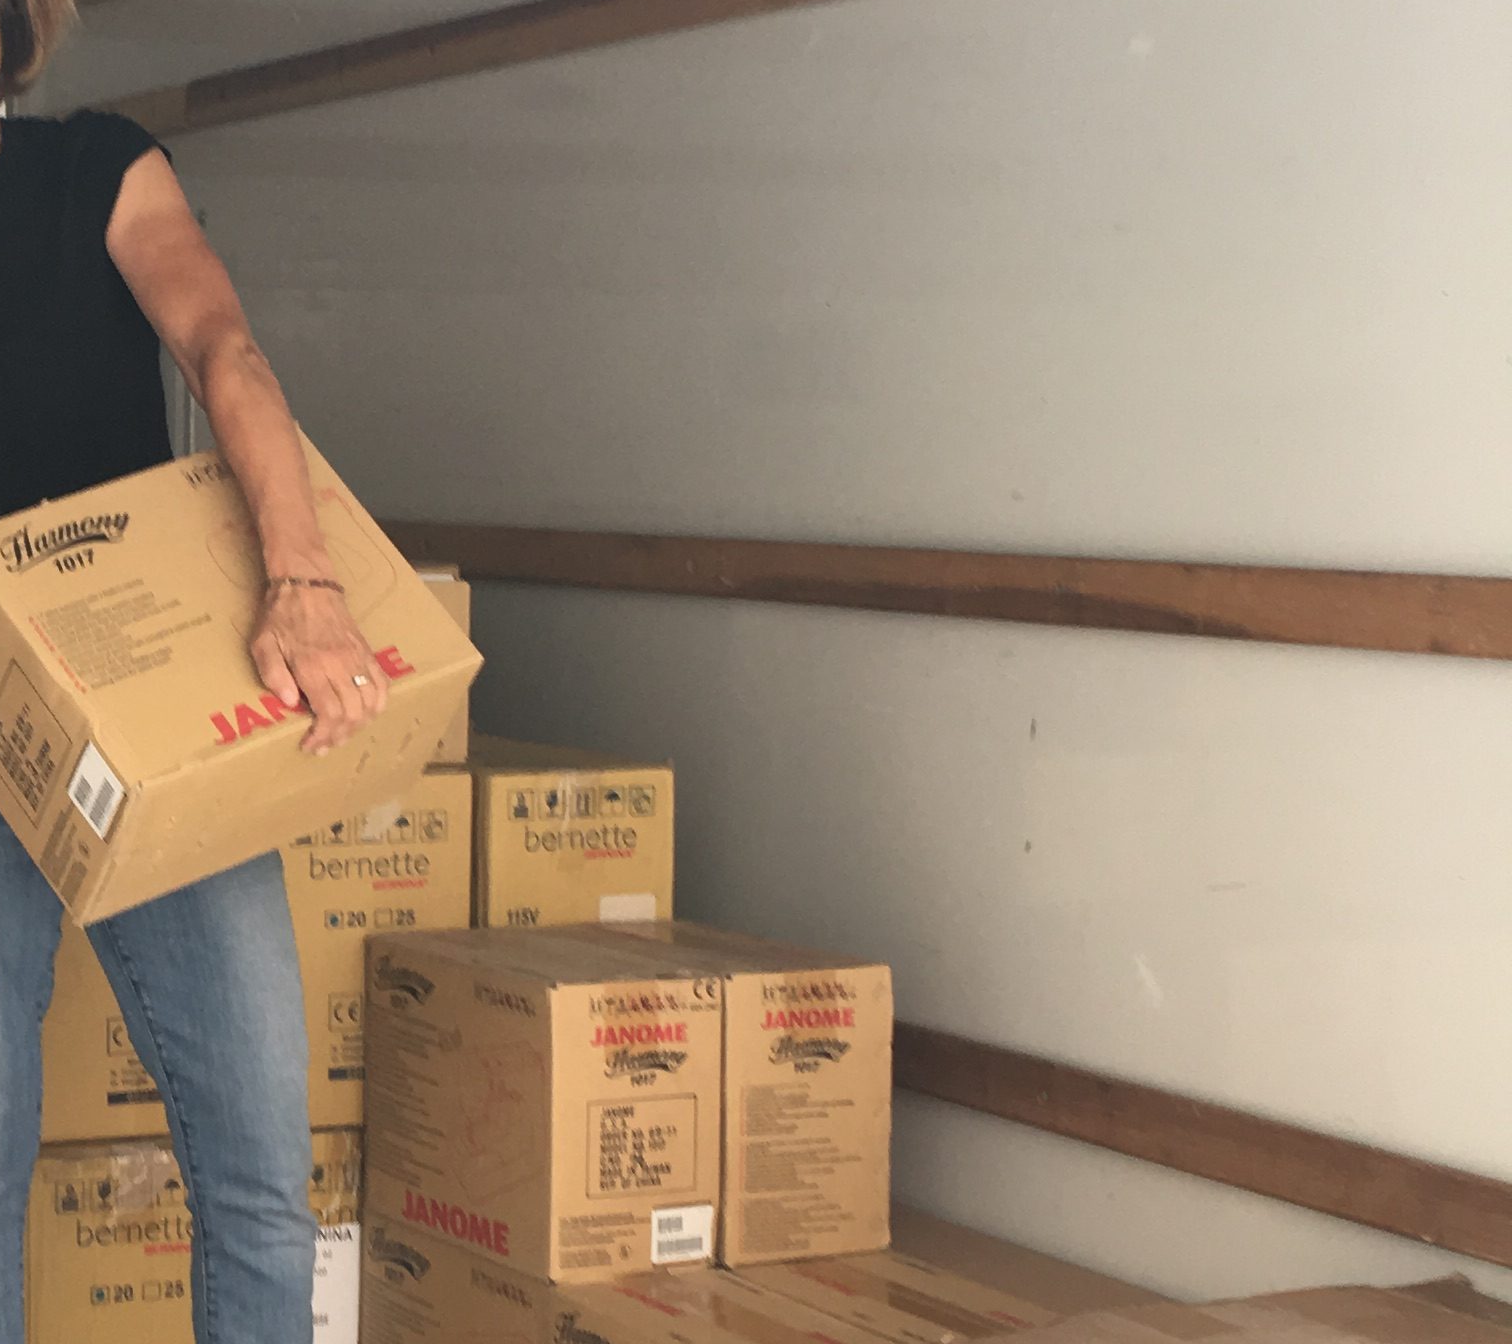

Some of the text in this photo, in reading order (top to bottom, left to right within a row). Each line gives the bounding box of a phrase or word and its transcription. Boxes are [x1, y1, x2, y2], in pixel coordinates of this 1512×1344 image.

[52, 547, 95, 575] 1017
[209, 644, 416, 747] JANE
[524, 824, 638, 854] bernette
[308, 851, 430, 882] bernette
[759, 1006, 856, 1032] JANOME
[589, 1022, 688, 1048] JANOME
[400, 1187, 510, 1256] JANOME
[114, 1283, 134, 1304] 20
